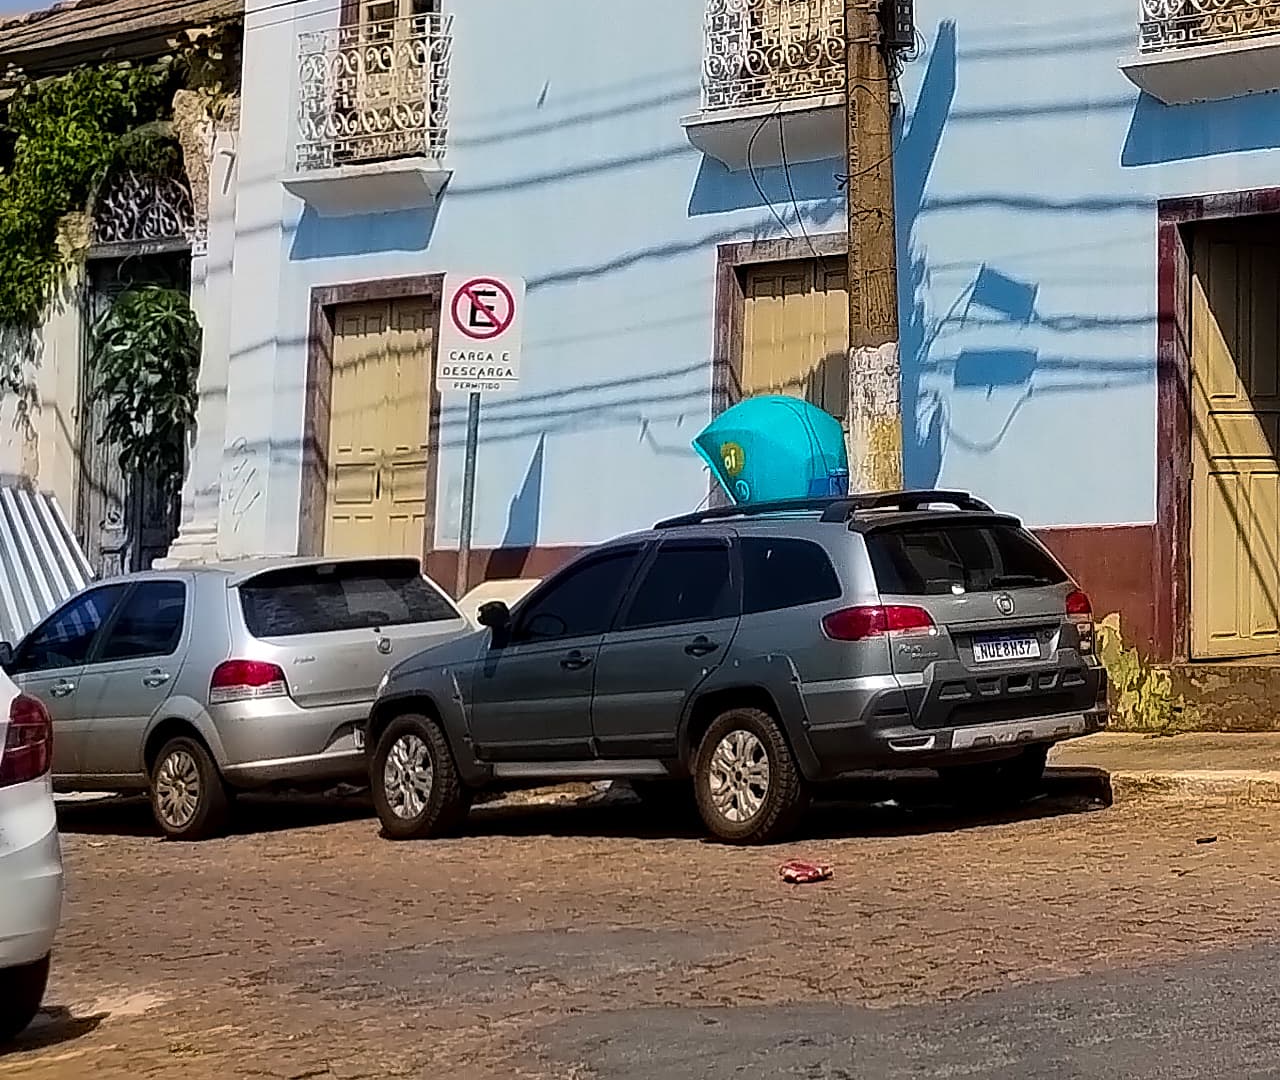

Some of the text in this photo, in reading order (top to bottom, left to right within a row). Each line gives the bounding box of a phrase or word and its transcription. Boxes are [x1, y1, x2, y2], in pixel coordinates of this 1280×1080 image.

[449, 351, 510, 361] CARGA E
[442, 366, 514, 377] DESCARGA
[453, 381, 500, 390] PERMITIDO
[980, 640, 1031, 660] NUE8H37
